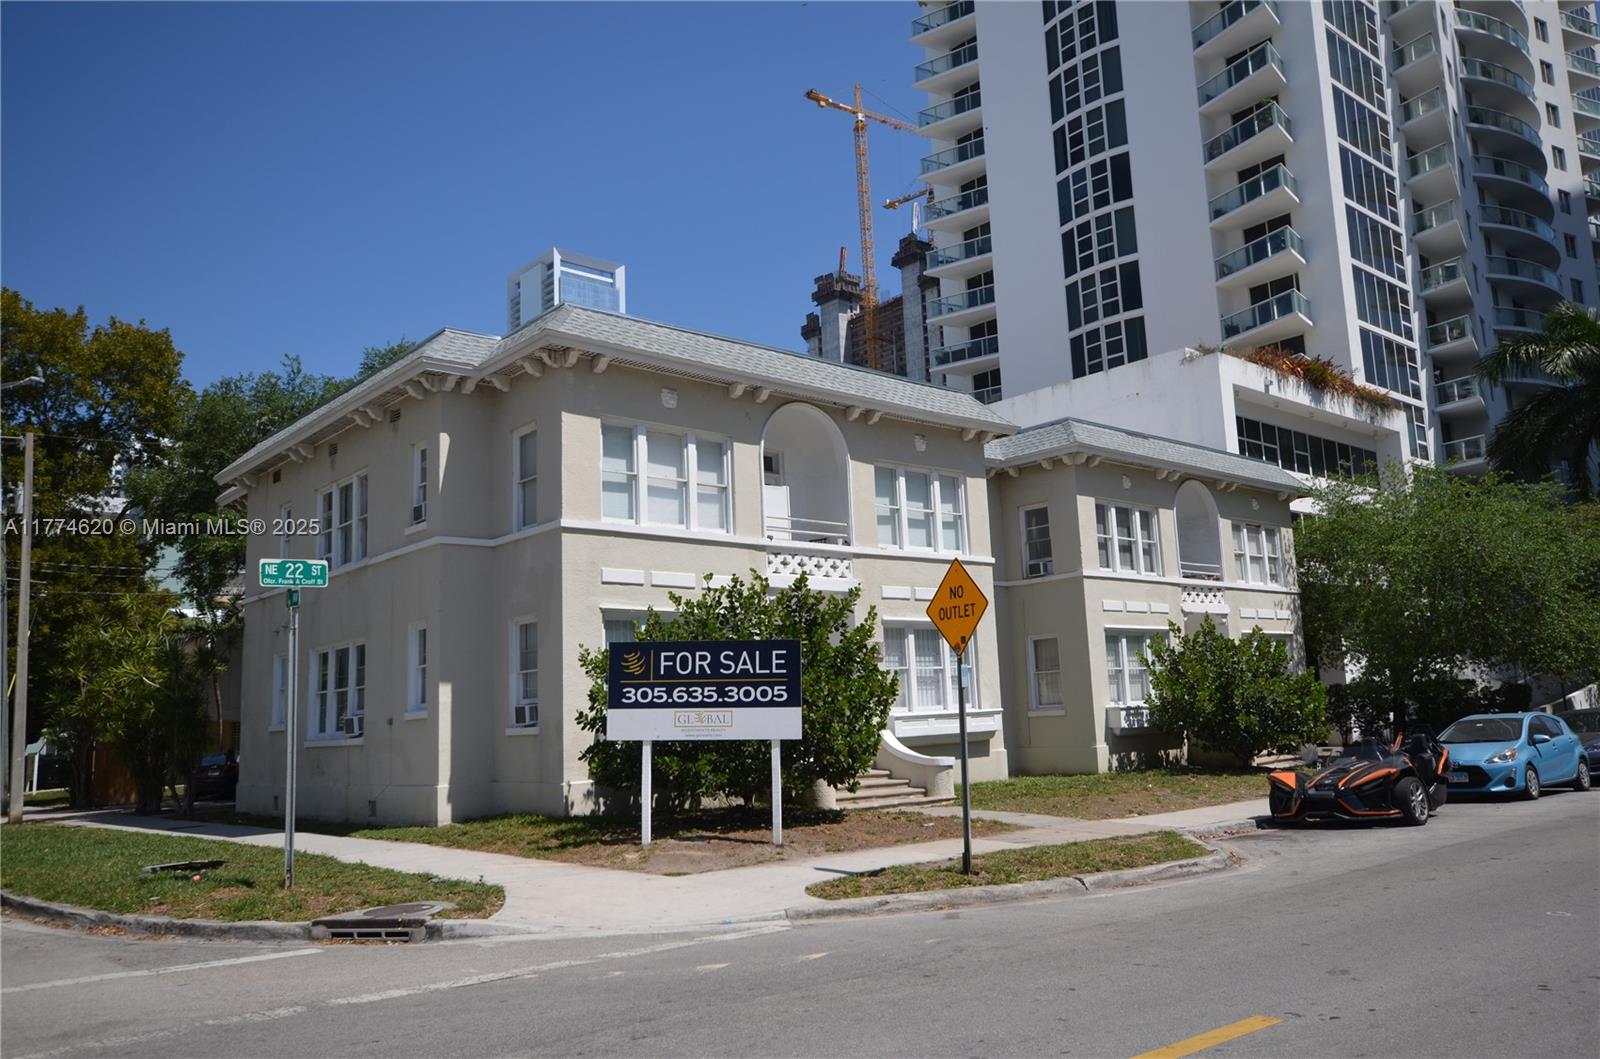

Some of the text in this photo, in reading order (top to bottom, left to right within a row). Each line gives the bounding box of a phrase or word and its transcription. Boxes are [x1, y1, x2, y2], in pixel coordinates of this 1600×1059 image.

[265, 563, 322, 578] NE 22 ST
[949, 585, 964, 600] NO
[938, 603, 976, 621] OUTLET
[660, 650, 787, 675] FOR SALE
[621, 686, 788, 703] 305.635.3005
